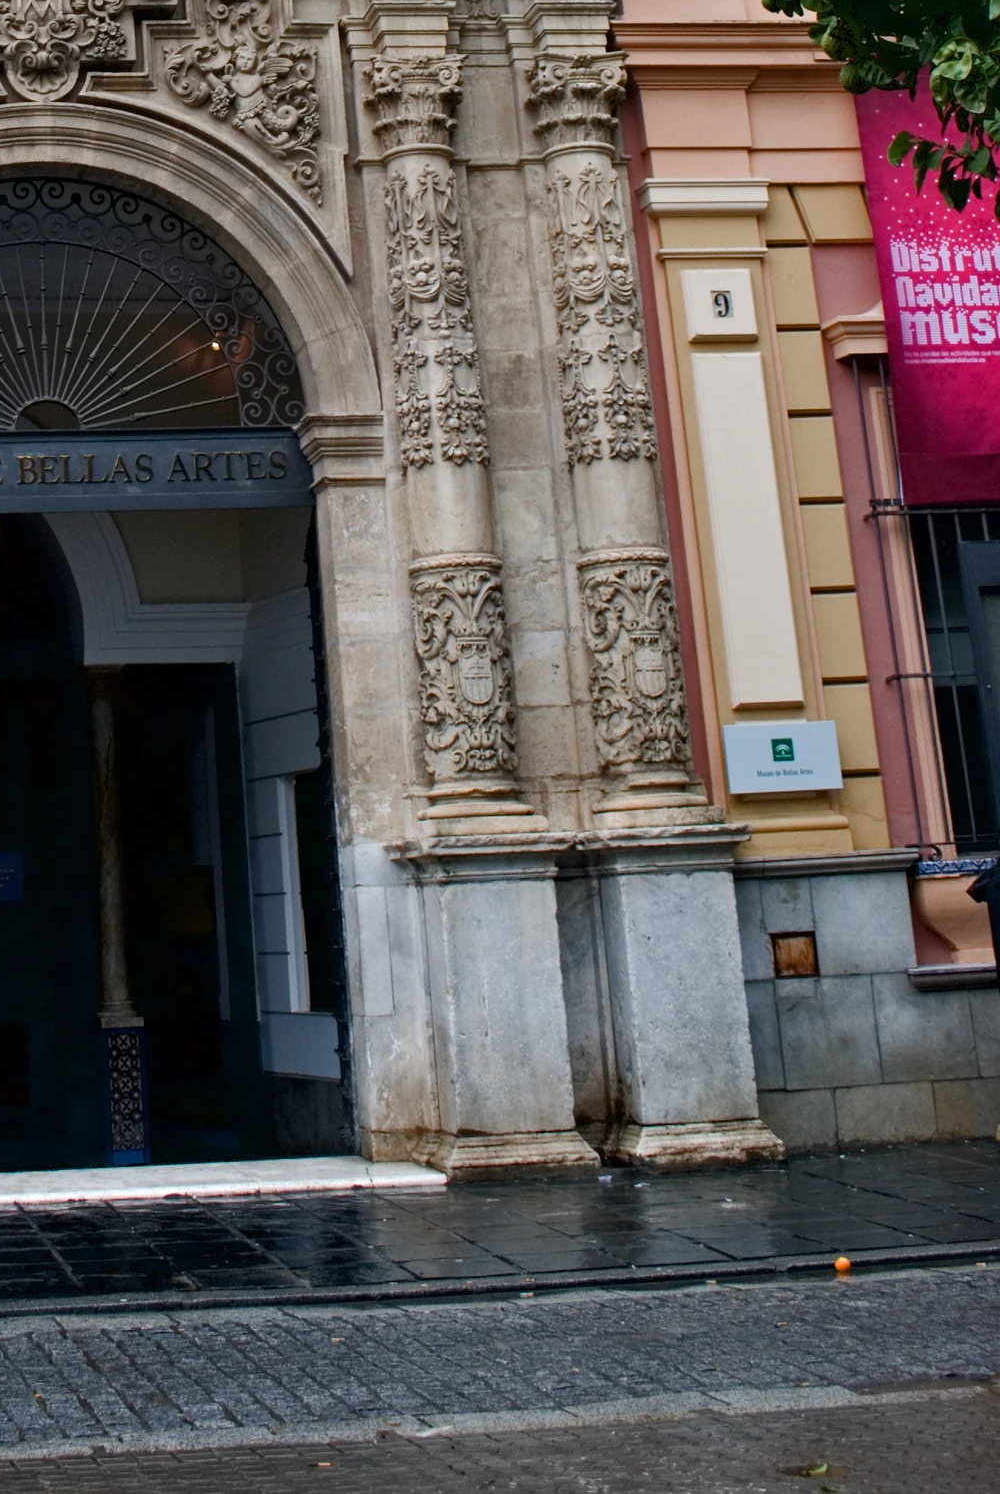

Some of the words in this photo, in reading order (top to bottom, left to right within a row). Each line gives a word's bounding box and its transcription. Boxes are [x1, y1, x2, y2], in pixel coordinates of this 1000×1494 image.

[714, 292, 730, 318] 9
[895, 274, 1000, 307] Navida
[900, 309, 1000, 345] mus
[16, 454, 153, 486] BELLAS
[167, 450, 287, 482] ARTES
